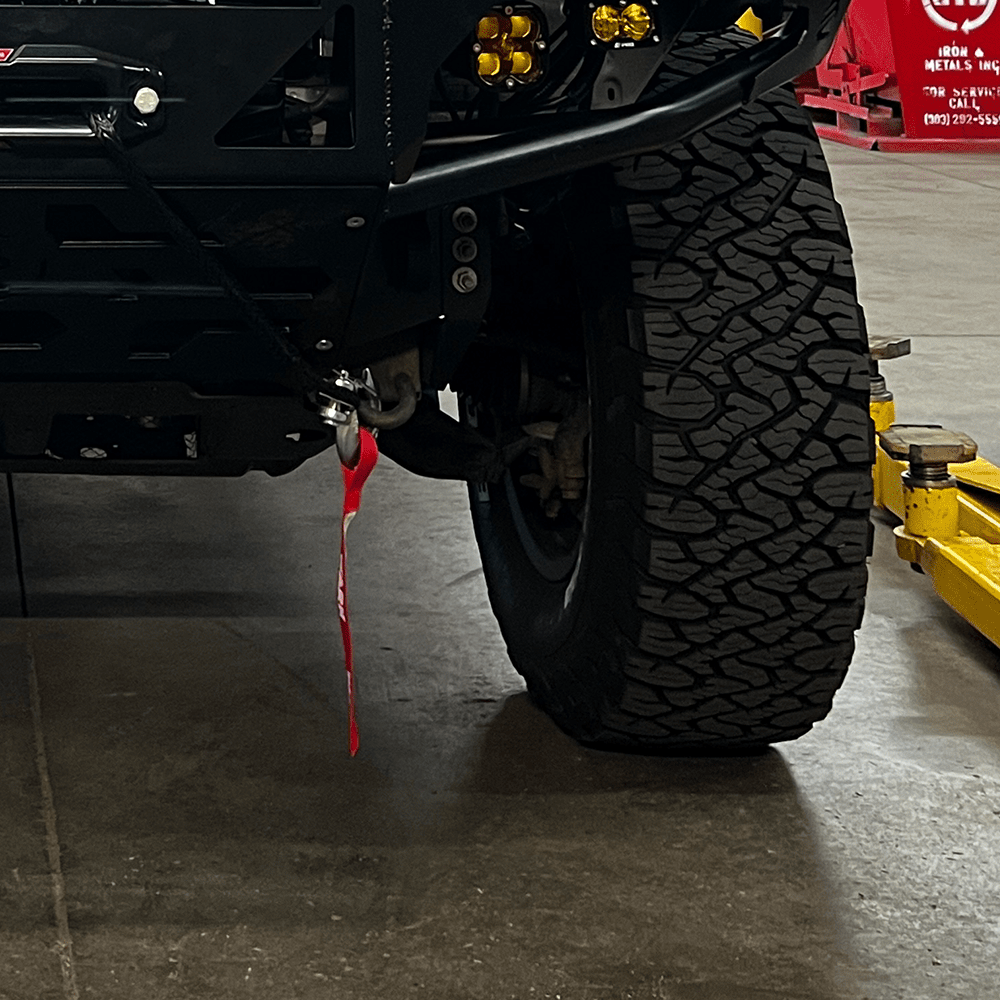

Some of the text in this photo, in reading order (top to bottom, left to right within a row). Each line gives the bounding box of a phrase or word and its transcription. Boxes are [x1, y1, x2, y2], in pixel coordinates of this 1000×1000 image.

[938, 45, 968, 58] IRON
[924, 59, 973, 71] METALS
[948, 97, 980, 110] CALL
[952, 112, 1000, 126] 292-555
